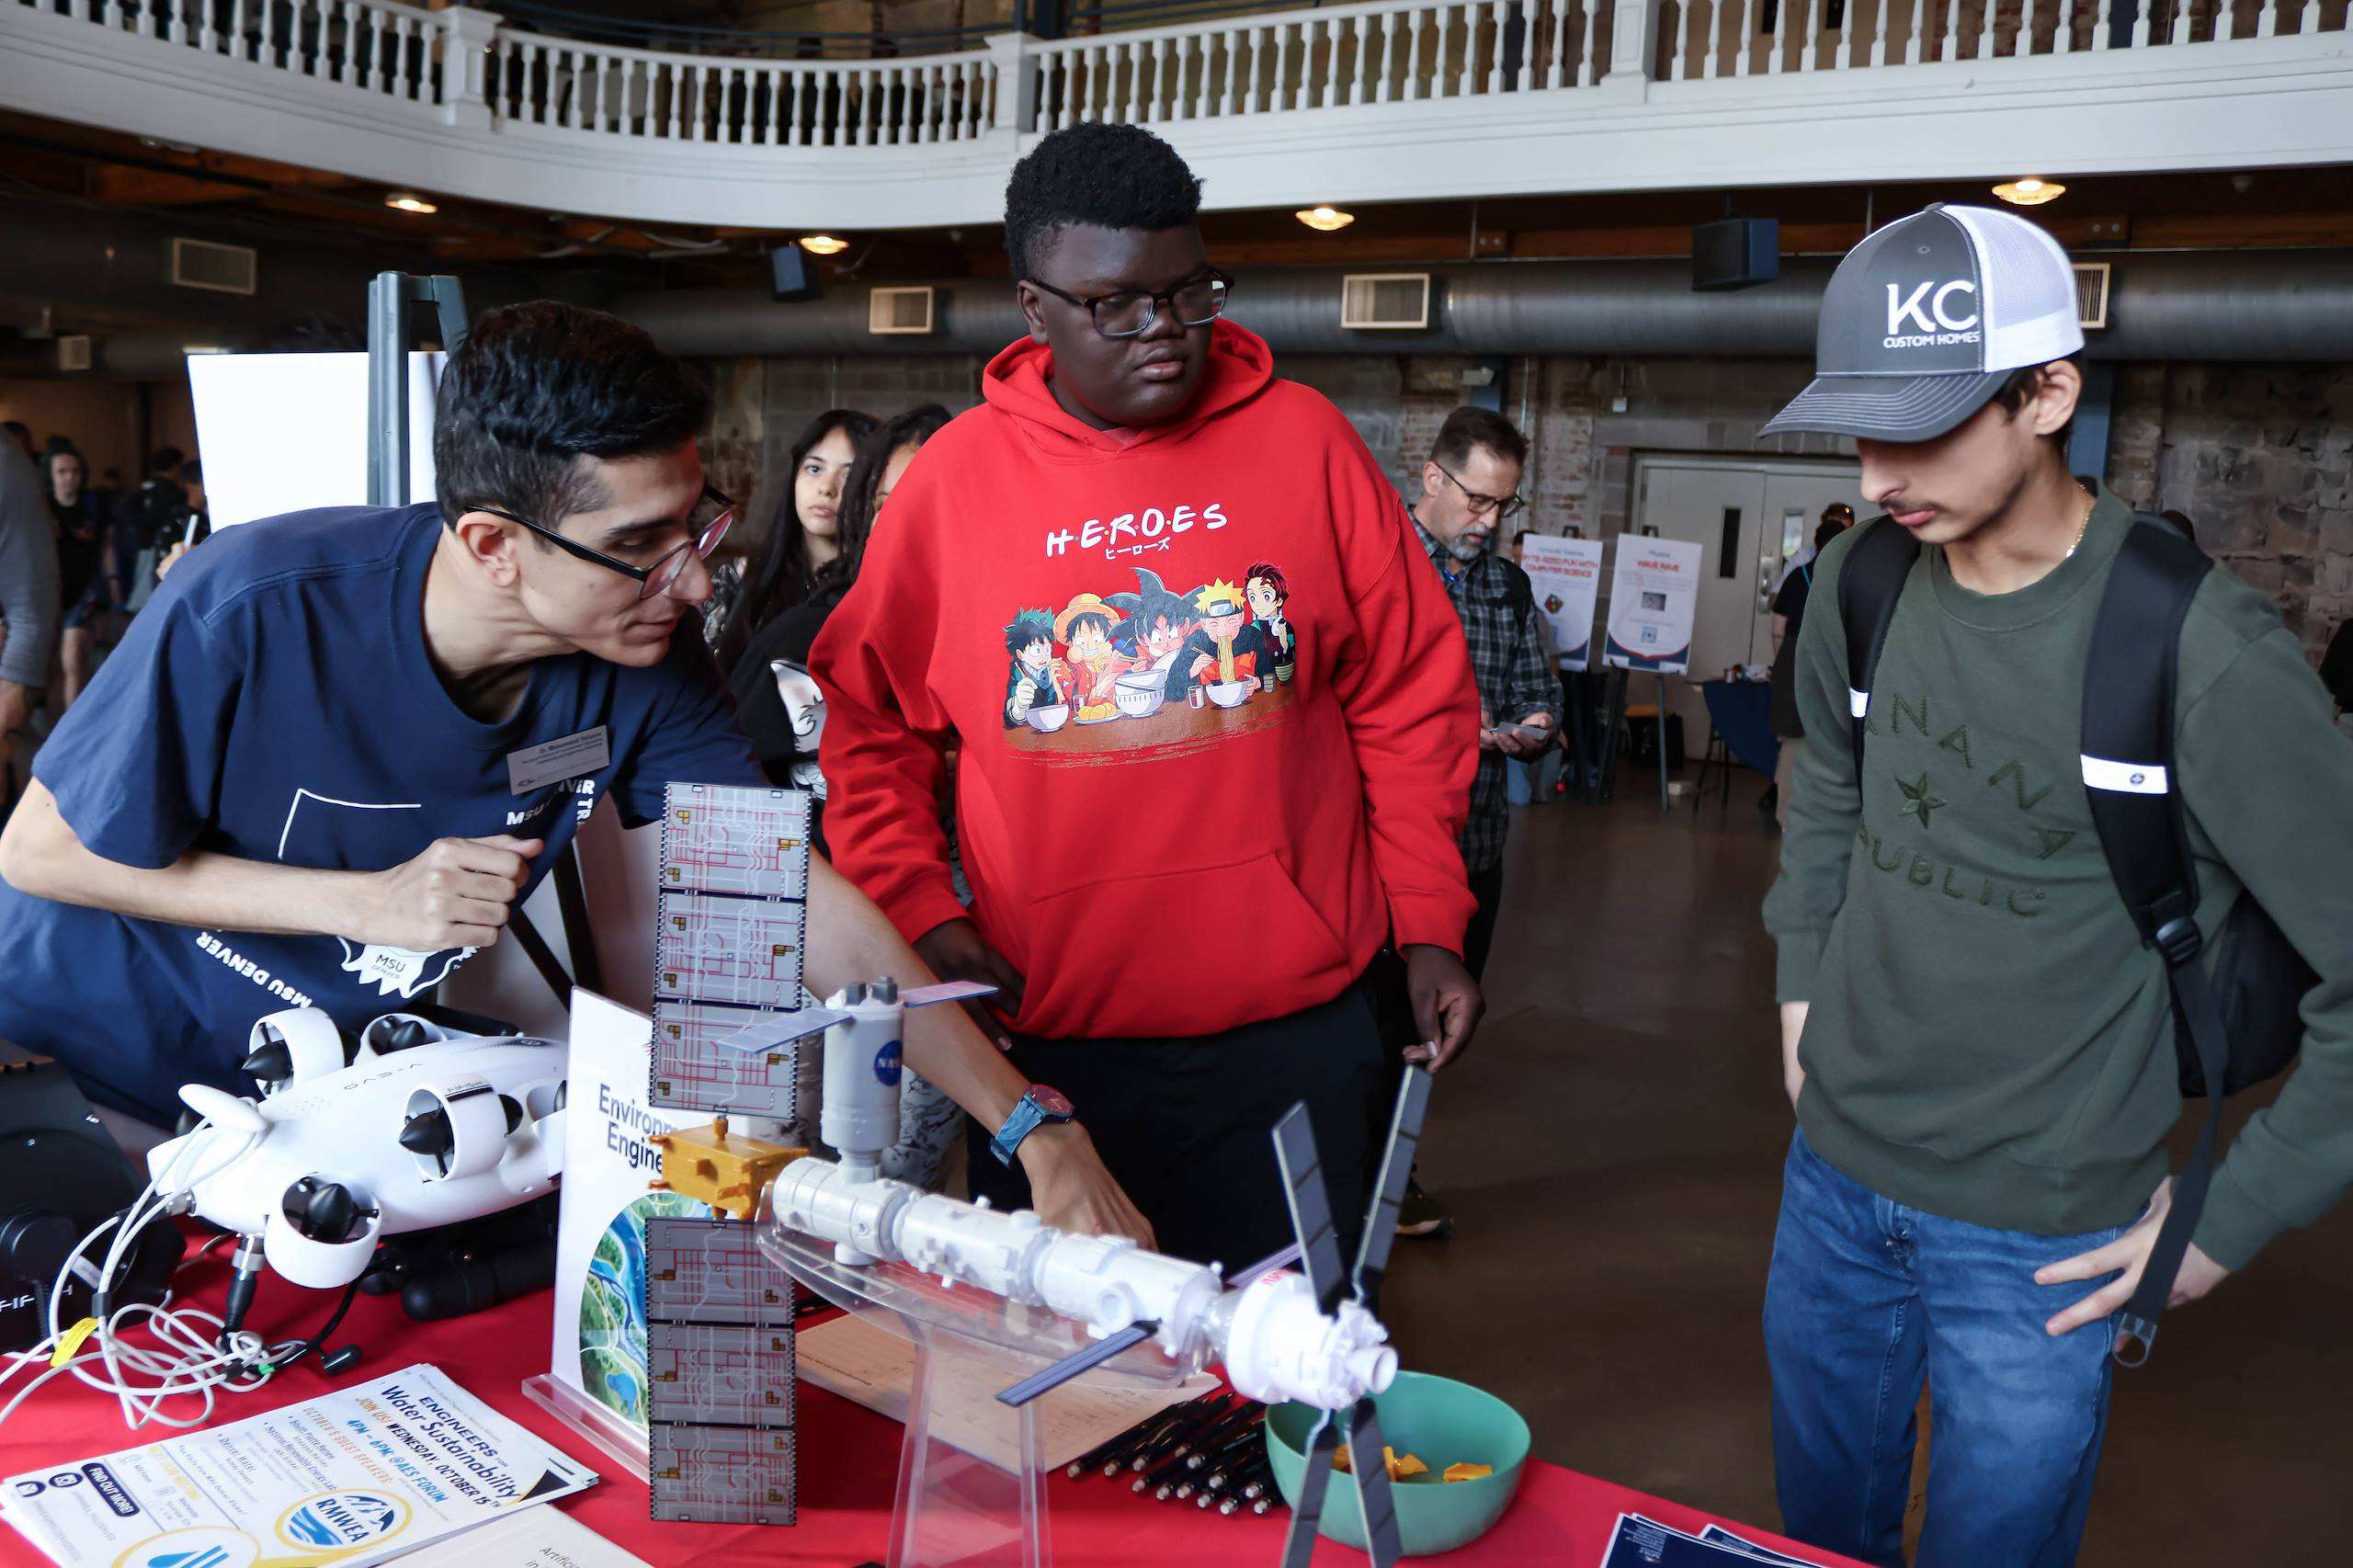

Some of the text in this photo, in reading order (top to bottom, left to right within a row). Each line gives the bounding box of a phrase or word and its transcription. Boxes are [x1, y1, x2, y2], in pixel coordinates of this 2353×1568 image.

[1886, 279, 1977, 335] KC
[1883, 331, 1980, 348] CUSTOM HOMES
[1105, 536, 1171, 561] ヒーローズ
[196, 931, 313, 1009] MSU DENVER
[375, 954, 406, 972] MSU
[381, 1385, 426, 1421] Water
[420, 1421, 520, 1498] Sustainability
[419, 1396, 498, 1458] ENGINEERS
[88, 1467, 108, 1483] FIND
[99, 1480, 120, 1496] OUT
[411, 1476, 449, 1504] FORUM
[435, 1464, 481, 1498] OCTOBER
[316, 1498, 369, 1543] RMWEA
